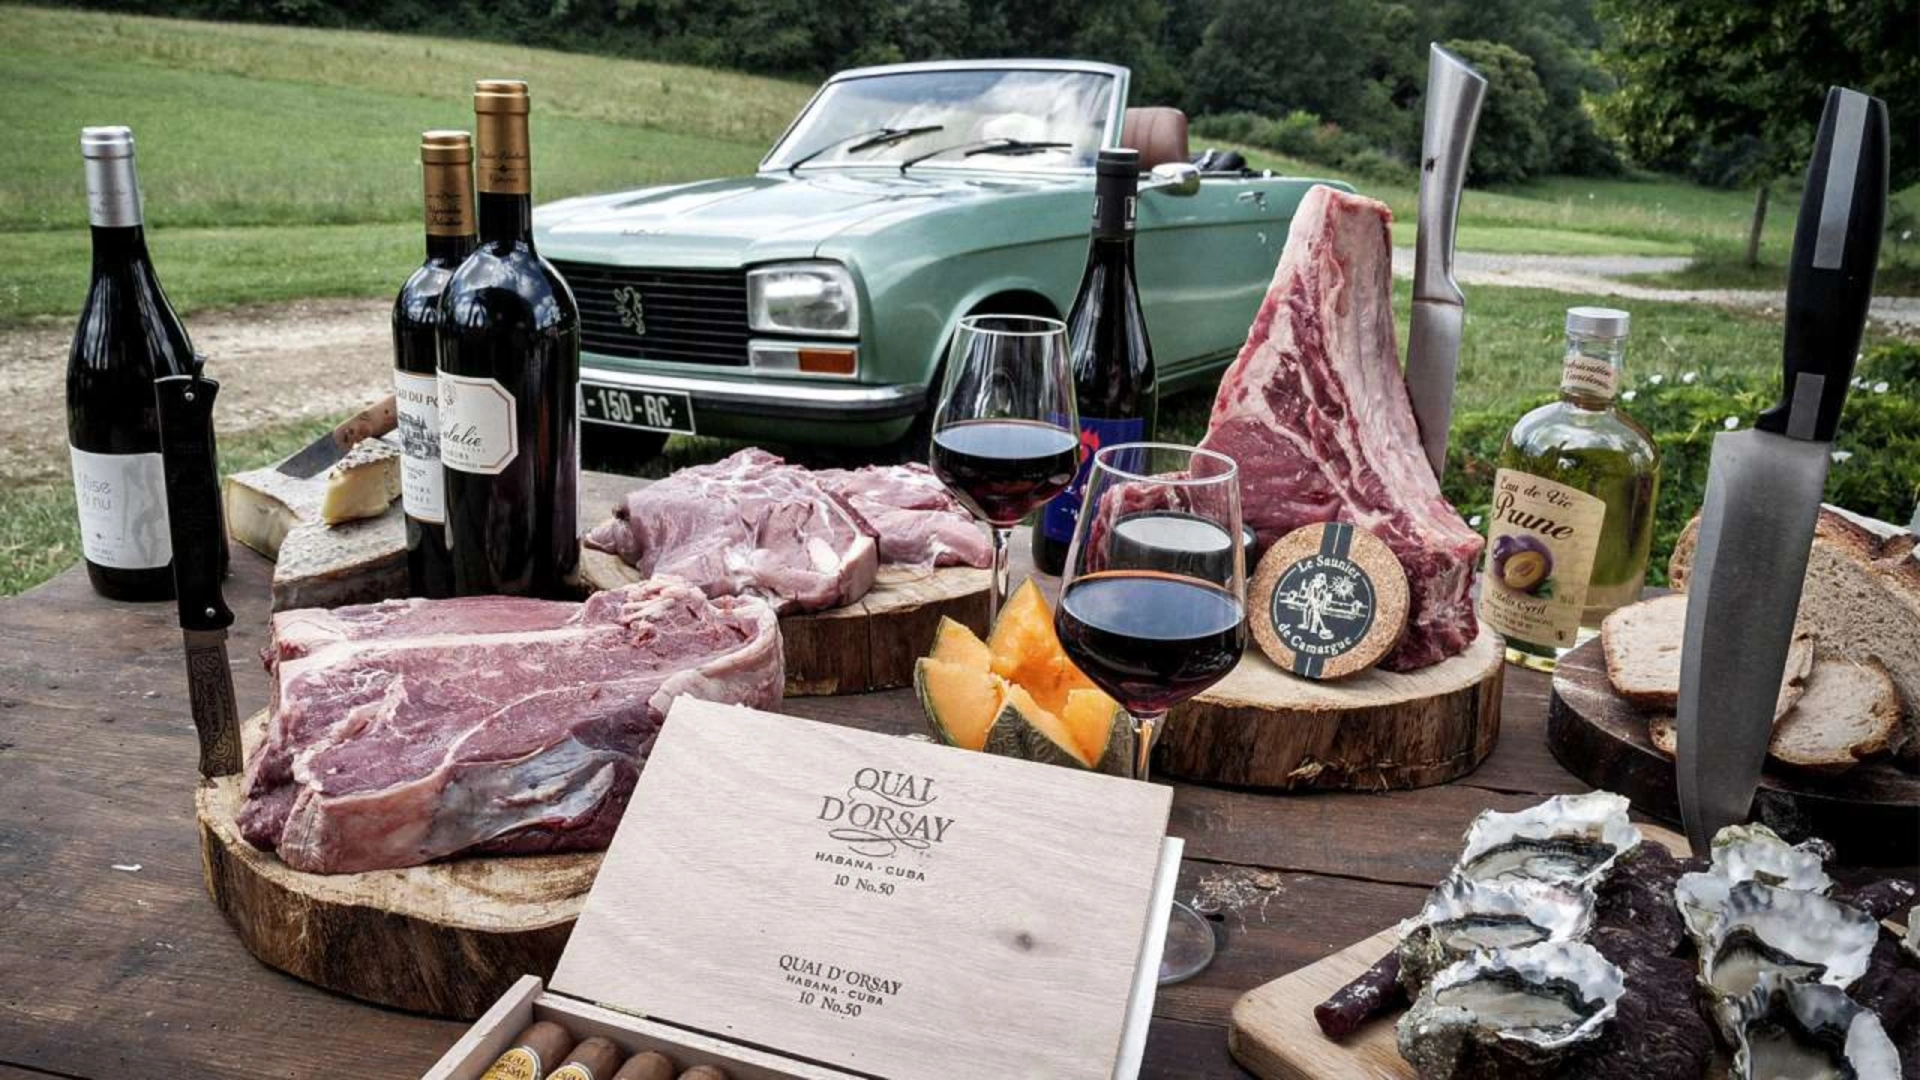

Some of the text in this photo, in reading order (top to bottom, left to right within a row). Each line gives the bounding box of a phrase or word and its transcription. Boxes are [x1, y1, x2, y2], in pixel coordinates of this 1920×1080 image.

[409, 391, 423, 404] DU
[1500, 476, 1573, 511] Eau de Vie
[1493, 491, 1574, 540] Prune
[1297, 554, 1362, 580] Le Saunier
[1277, 622, 1352, 656] de Camargue
[850, 767, 938, 807] QUAI
[817, 794, 955, 845] D'ORSAY
[815, 851, 926, 882] HABANA CUBA
[834, 873, 895, 896] 10 No.50
[779, 954, 903, 996] QUAI D'ORSAY
[786, 974, 884, 1006] HABANA CUBA
[798, 990, 862, 1017] 10 No.50
